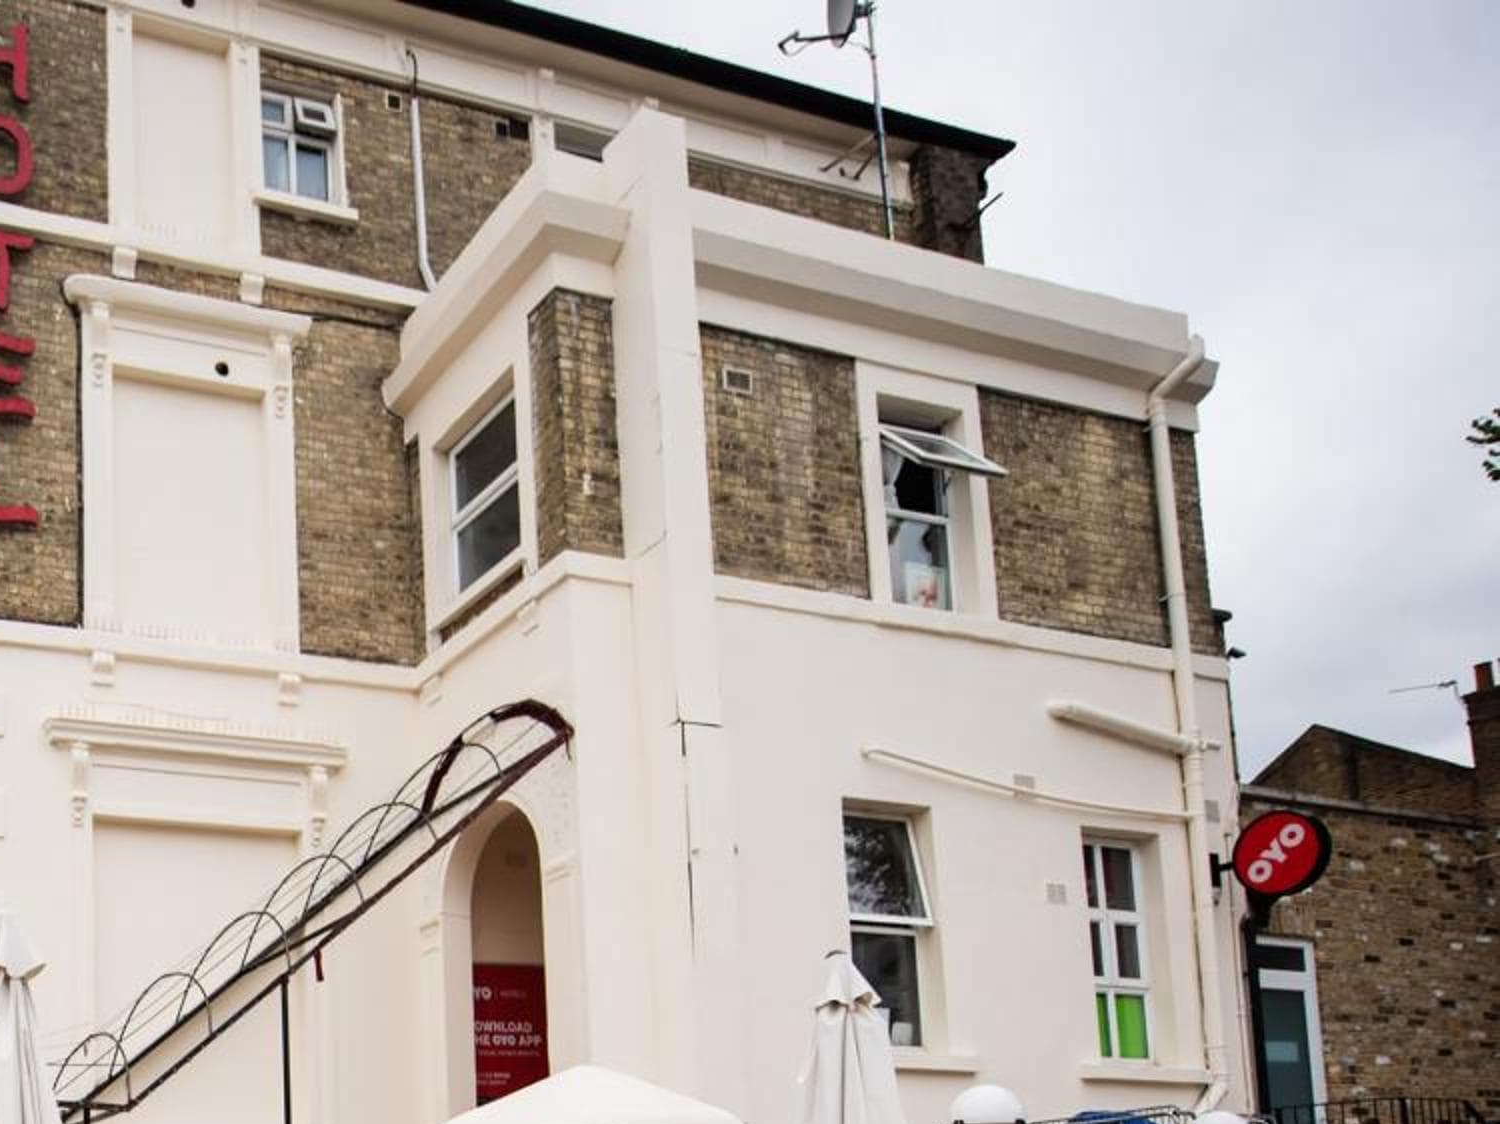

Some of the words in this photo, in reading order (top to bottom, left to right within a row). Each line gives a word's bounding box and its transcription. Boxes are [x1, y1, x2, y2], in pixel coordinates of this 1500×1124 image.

[1248, 823, 1306, 884] OYO
[474, 986, 493, 1000] YO
[474, 1021, 533, 1033] OWNLOAD
[474, 1034, 491, 1047] HE
[492, 1035, 517, 1046] OYO
[518, 1036, 542, 1048] APP
